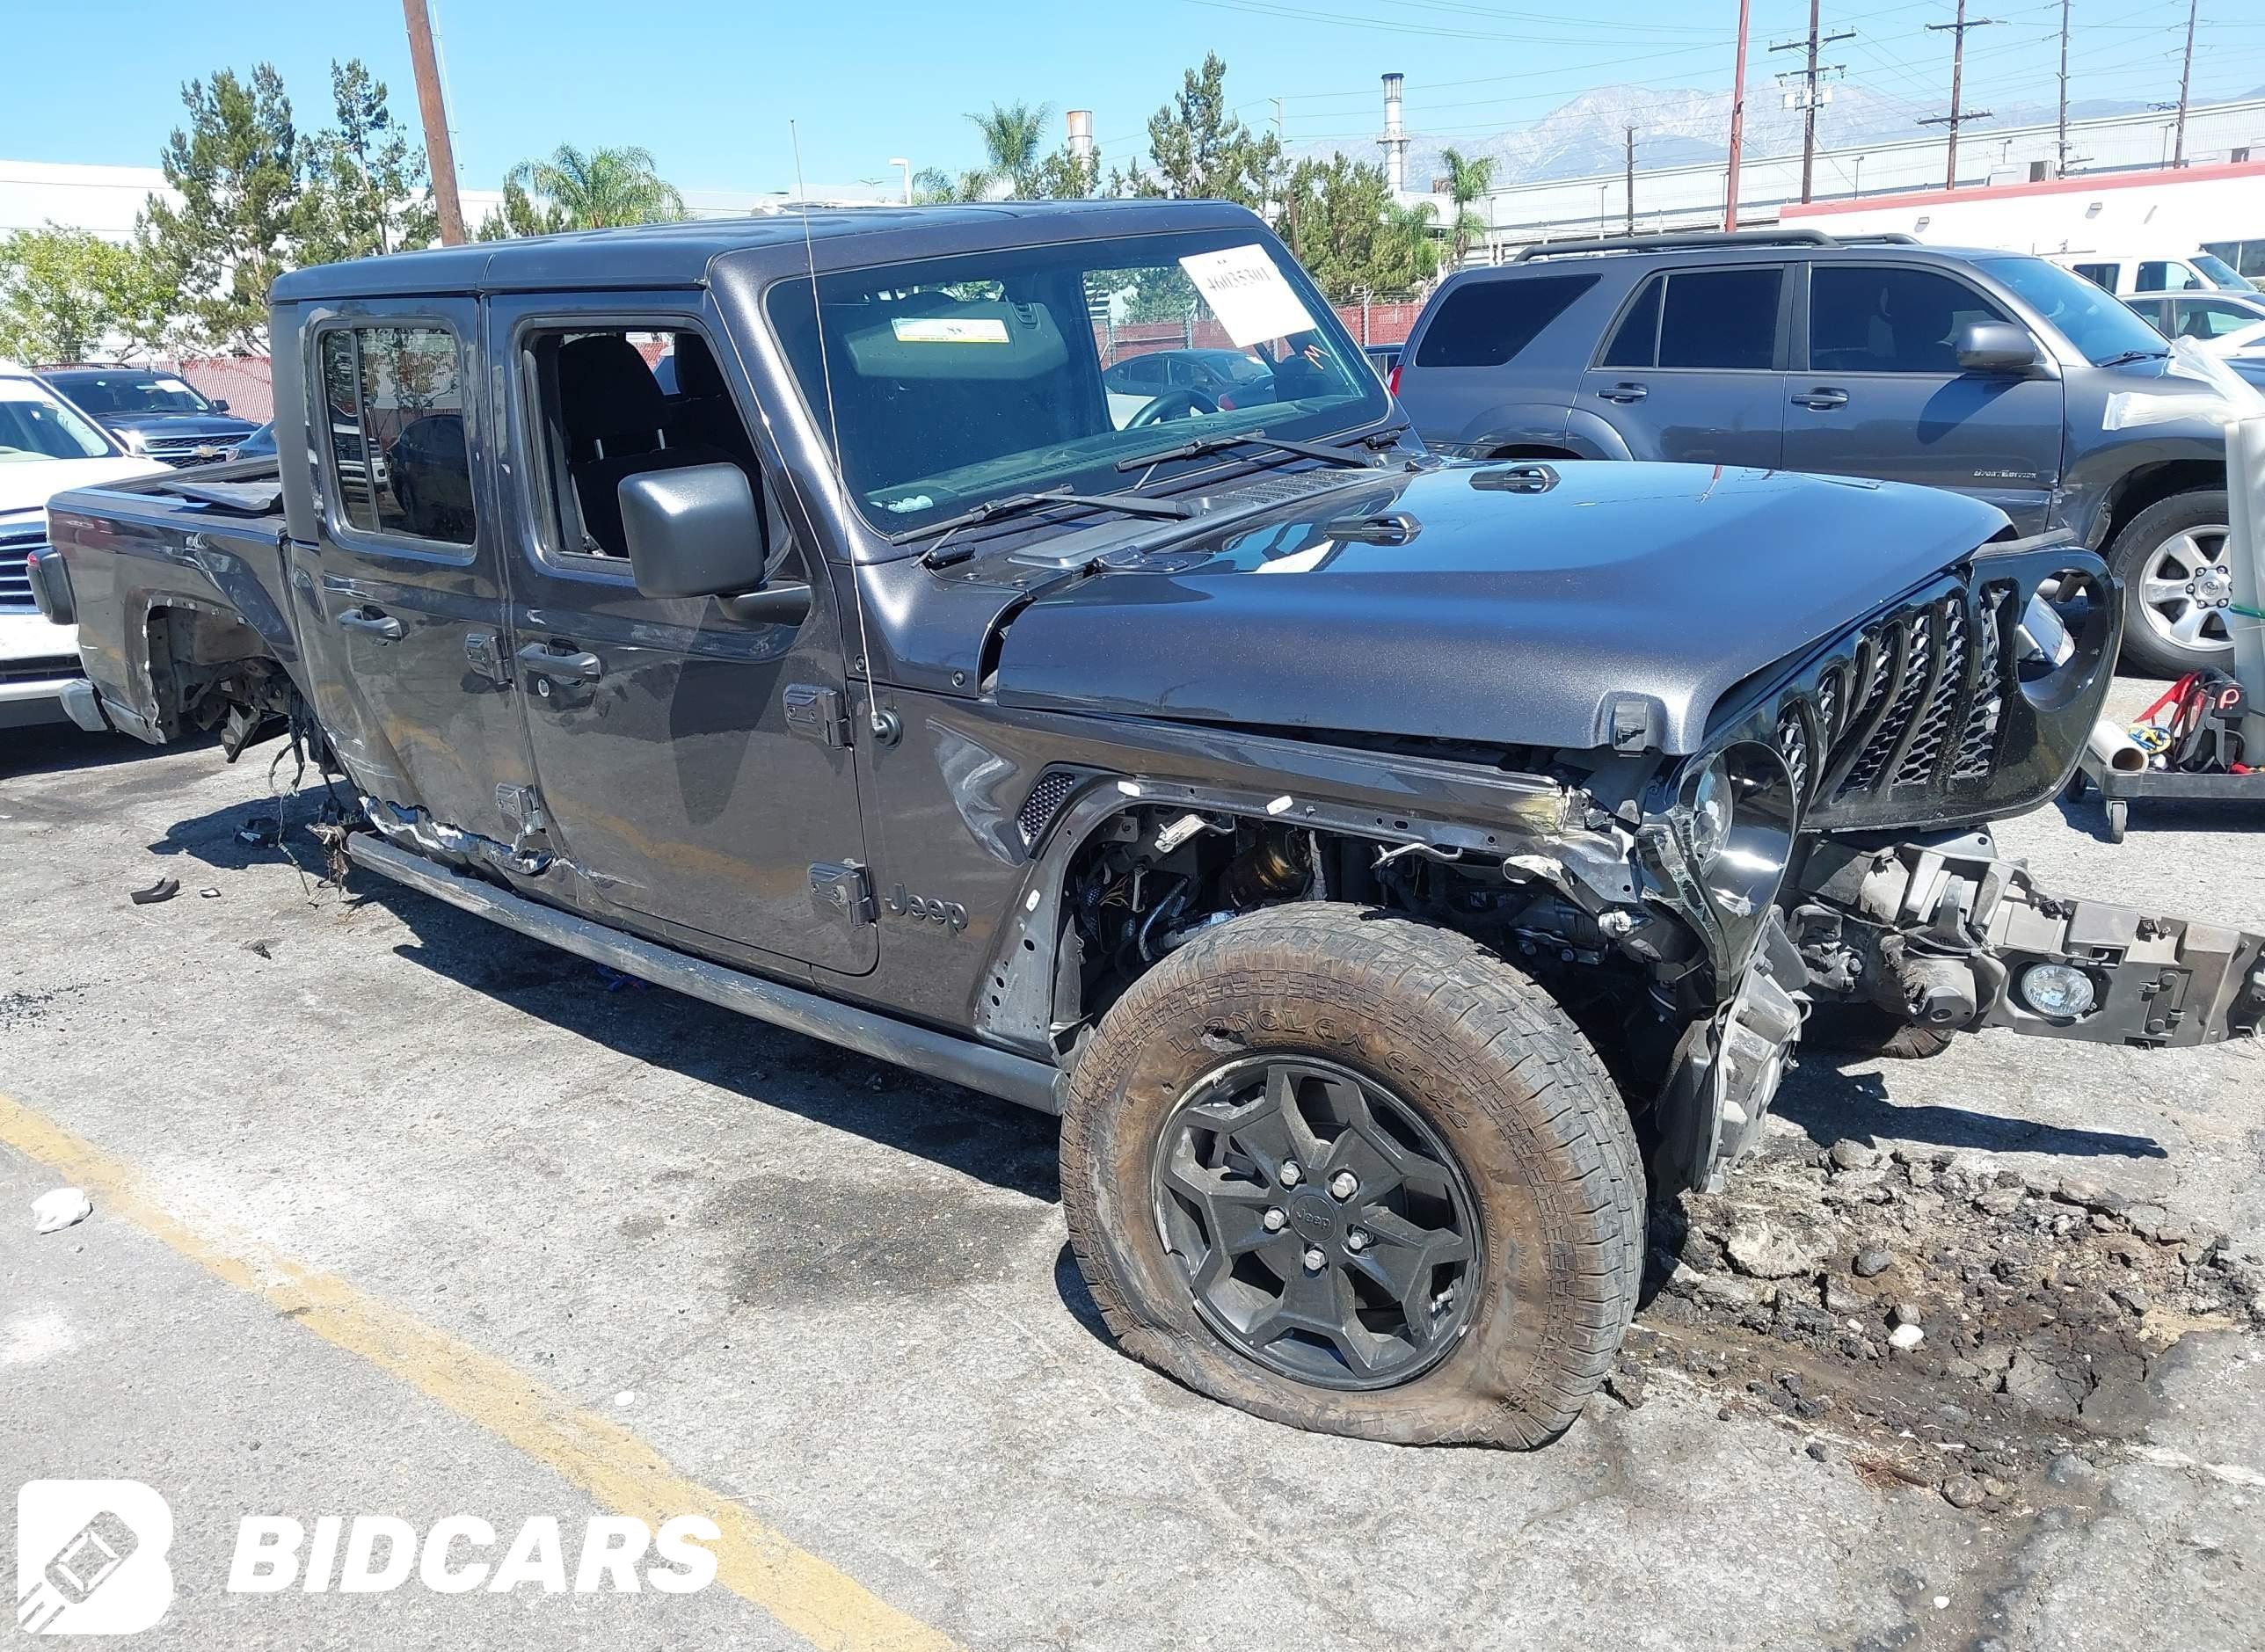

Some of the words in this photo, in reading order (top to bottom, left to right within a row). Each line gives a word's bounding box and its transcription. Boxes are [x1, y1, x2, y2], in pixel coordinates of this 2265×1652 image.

[1207, 267, 1271, 292] 46035301
[884, 882, 969, 936] Jeep
[1295, 1207, 1331, 1230] Jeep
